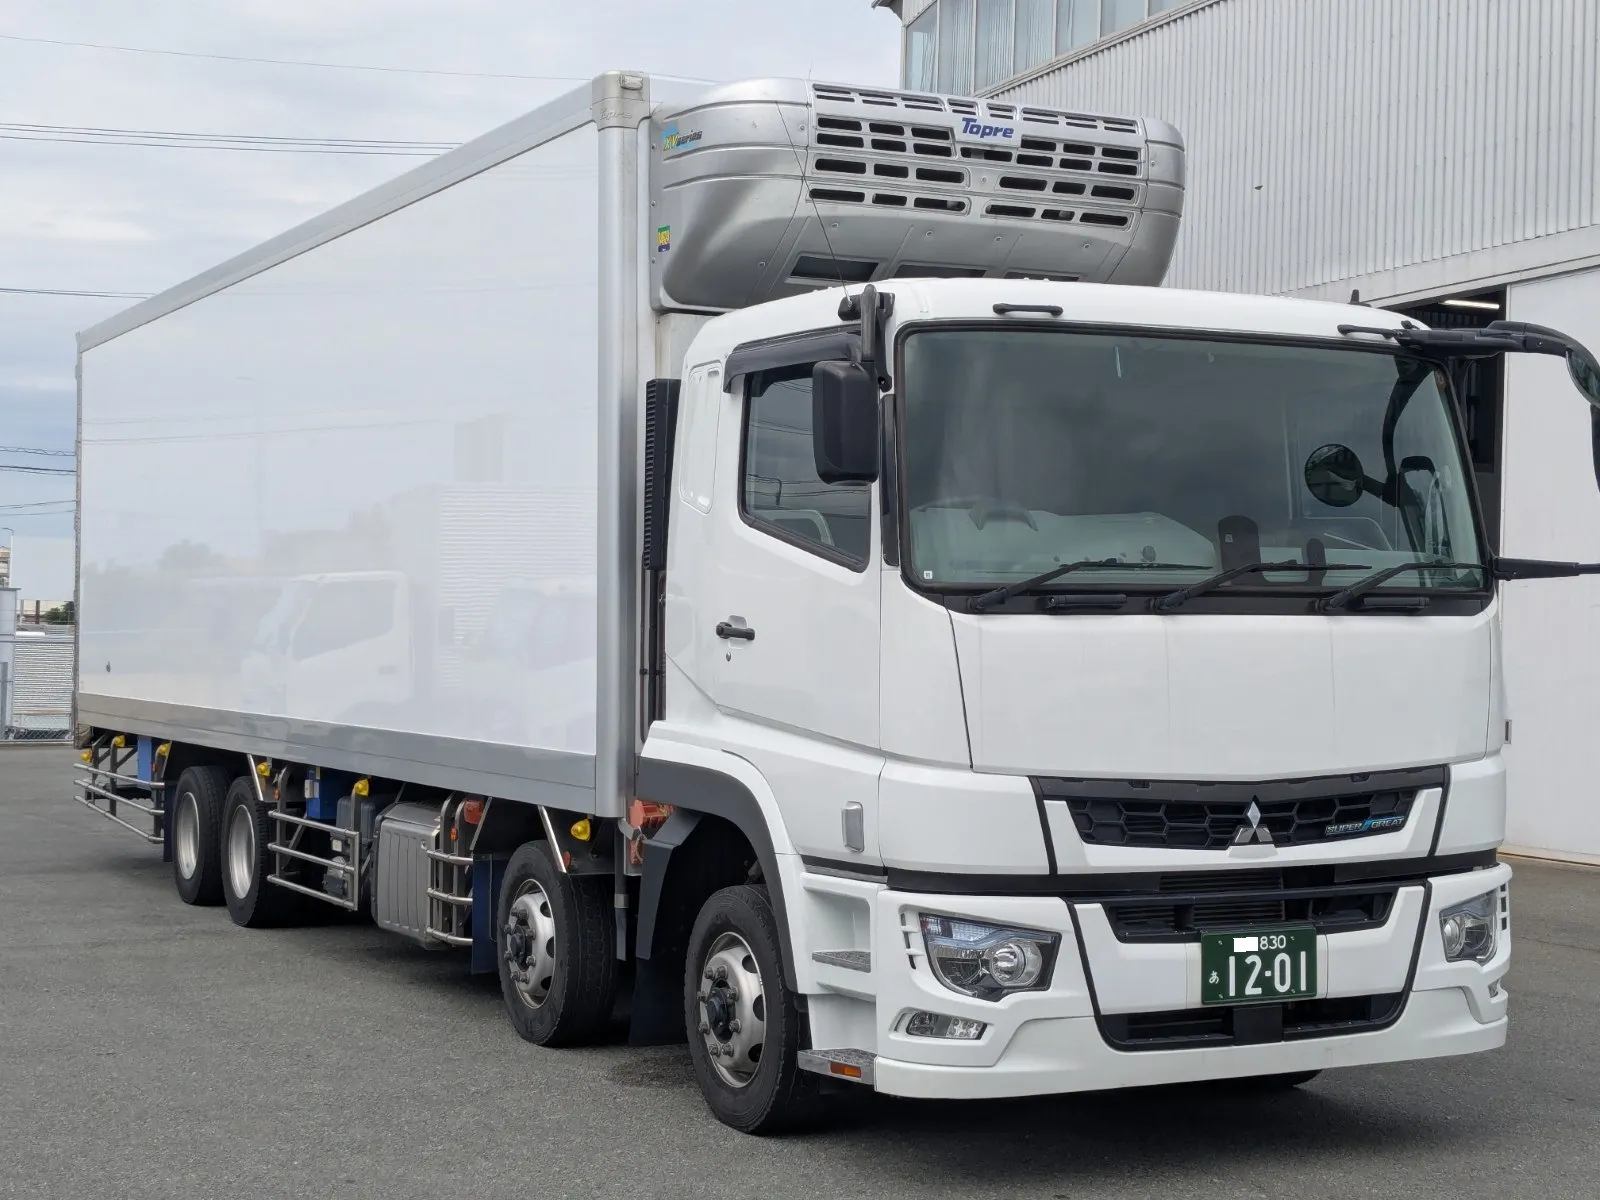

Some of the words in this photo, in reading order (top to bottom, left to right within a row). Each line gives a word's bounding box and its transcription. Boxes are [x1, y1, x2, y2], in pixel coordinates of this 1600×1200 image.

[962, 117, 1014, 138] Topre
[1326, 822, 1362, 833] SUPER
[1371, 818, 1404, 829] GREAT
[1259, 935, 1287, 950] 830
[1208, 970, 1220, 984] あ
[1228, 951, 1307, 997] 12-01
